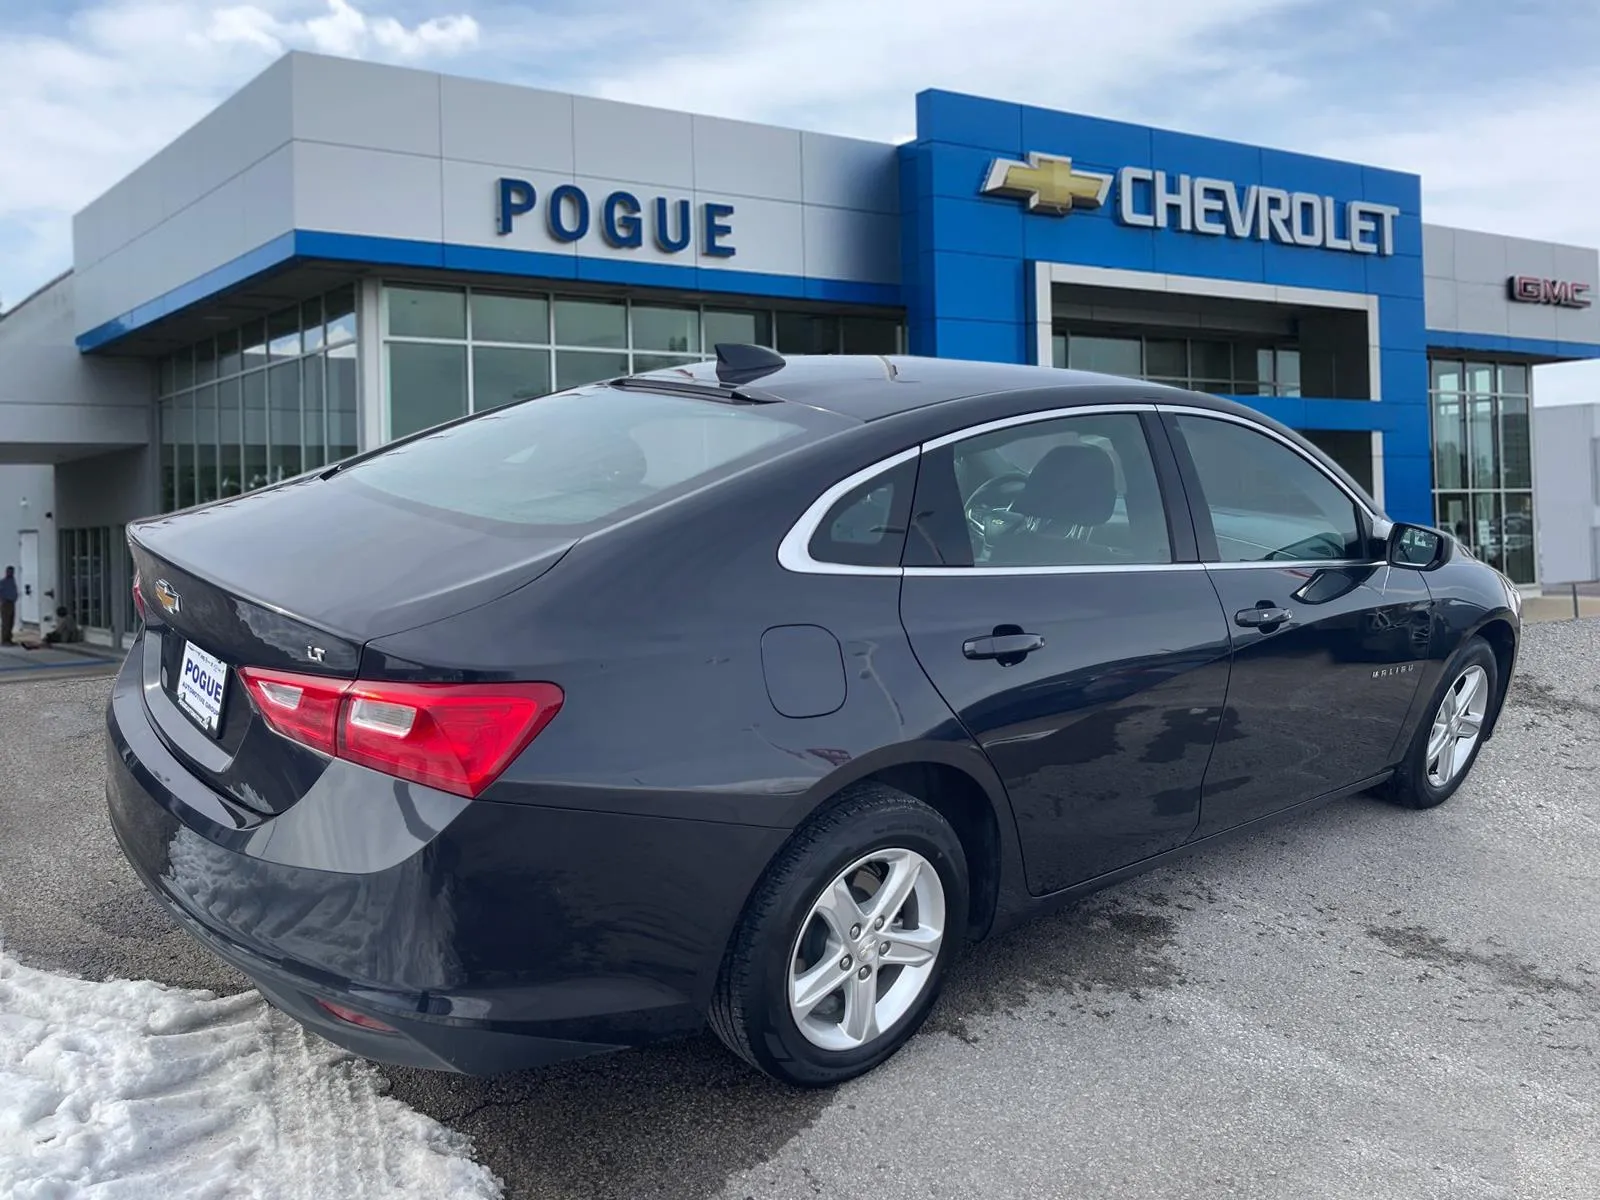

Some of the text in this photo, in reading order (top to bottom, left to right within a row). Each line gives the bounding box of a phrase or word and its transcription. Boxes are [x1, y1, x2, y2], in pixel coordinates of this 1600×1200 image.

[496, 177, 737, 259] POGUE
[1118, 165, 1400, 256] CHEVROLET
[1507, 275, 1592, 309] GMC
[307, 645, 326, 662] LT
[1372, 664, 1414, 679] MALIBU
[185, 658, 223, 704] POGUE
